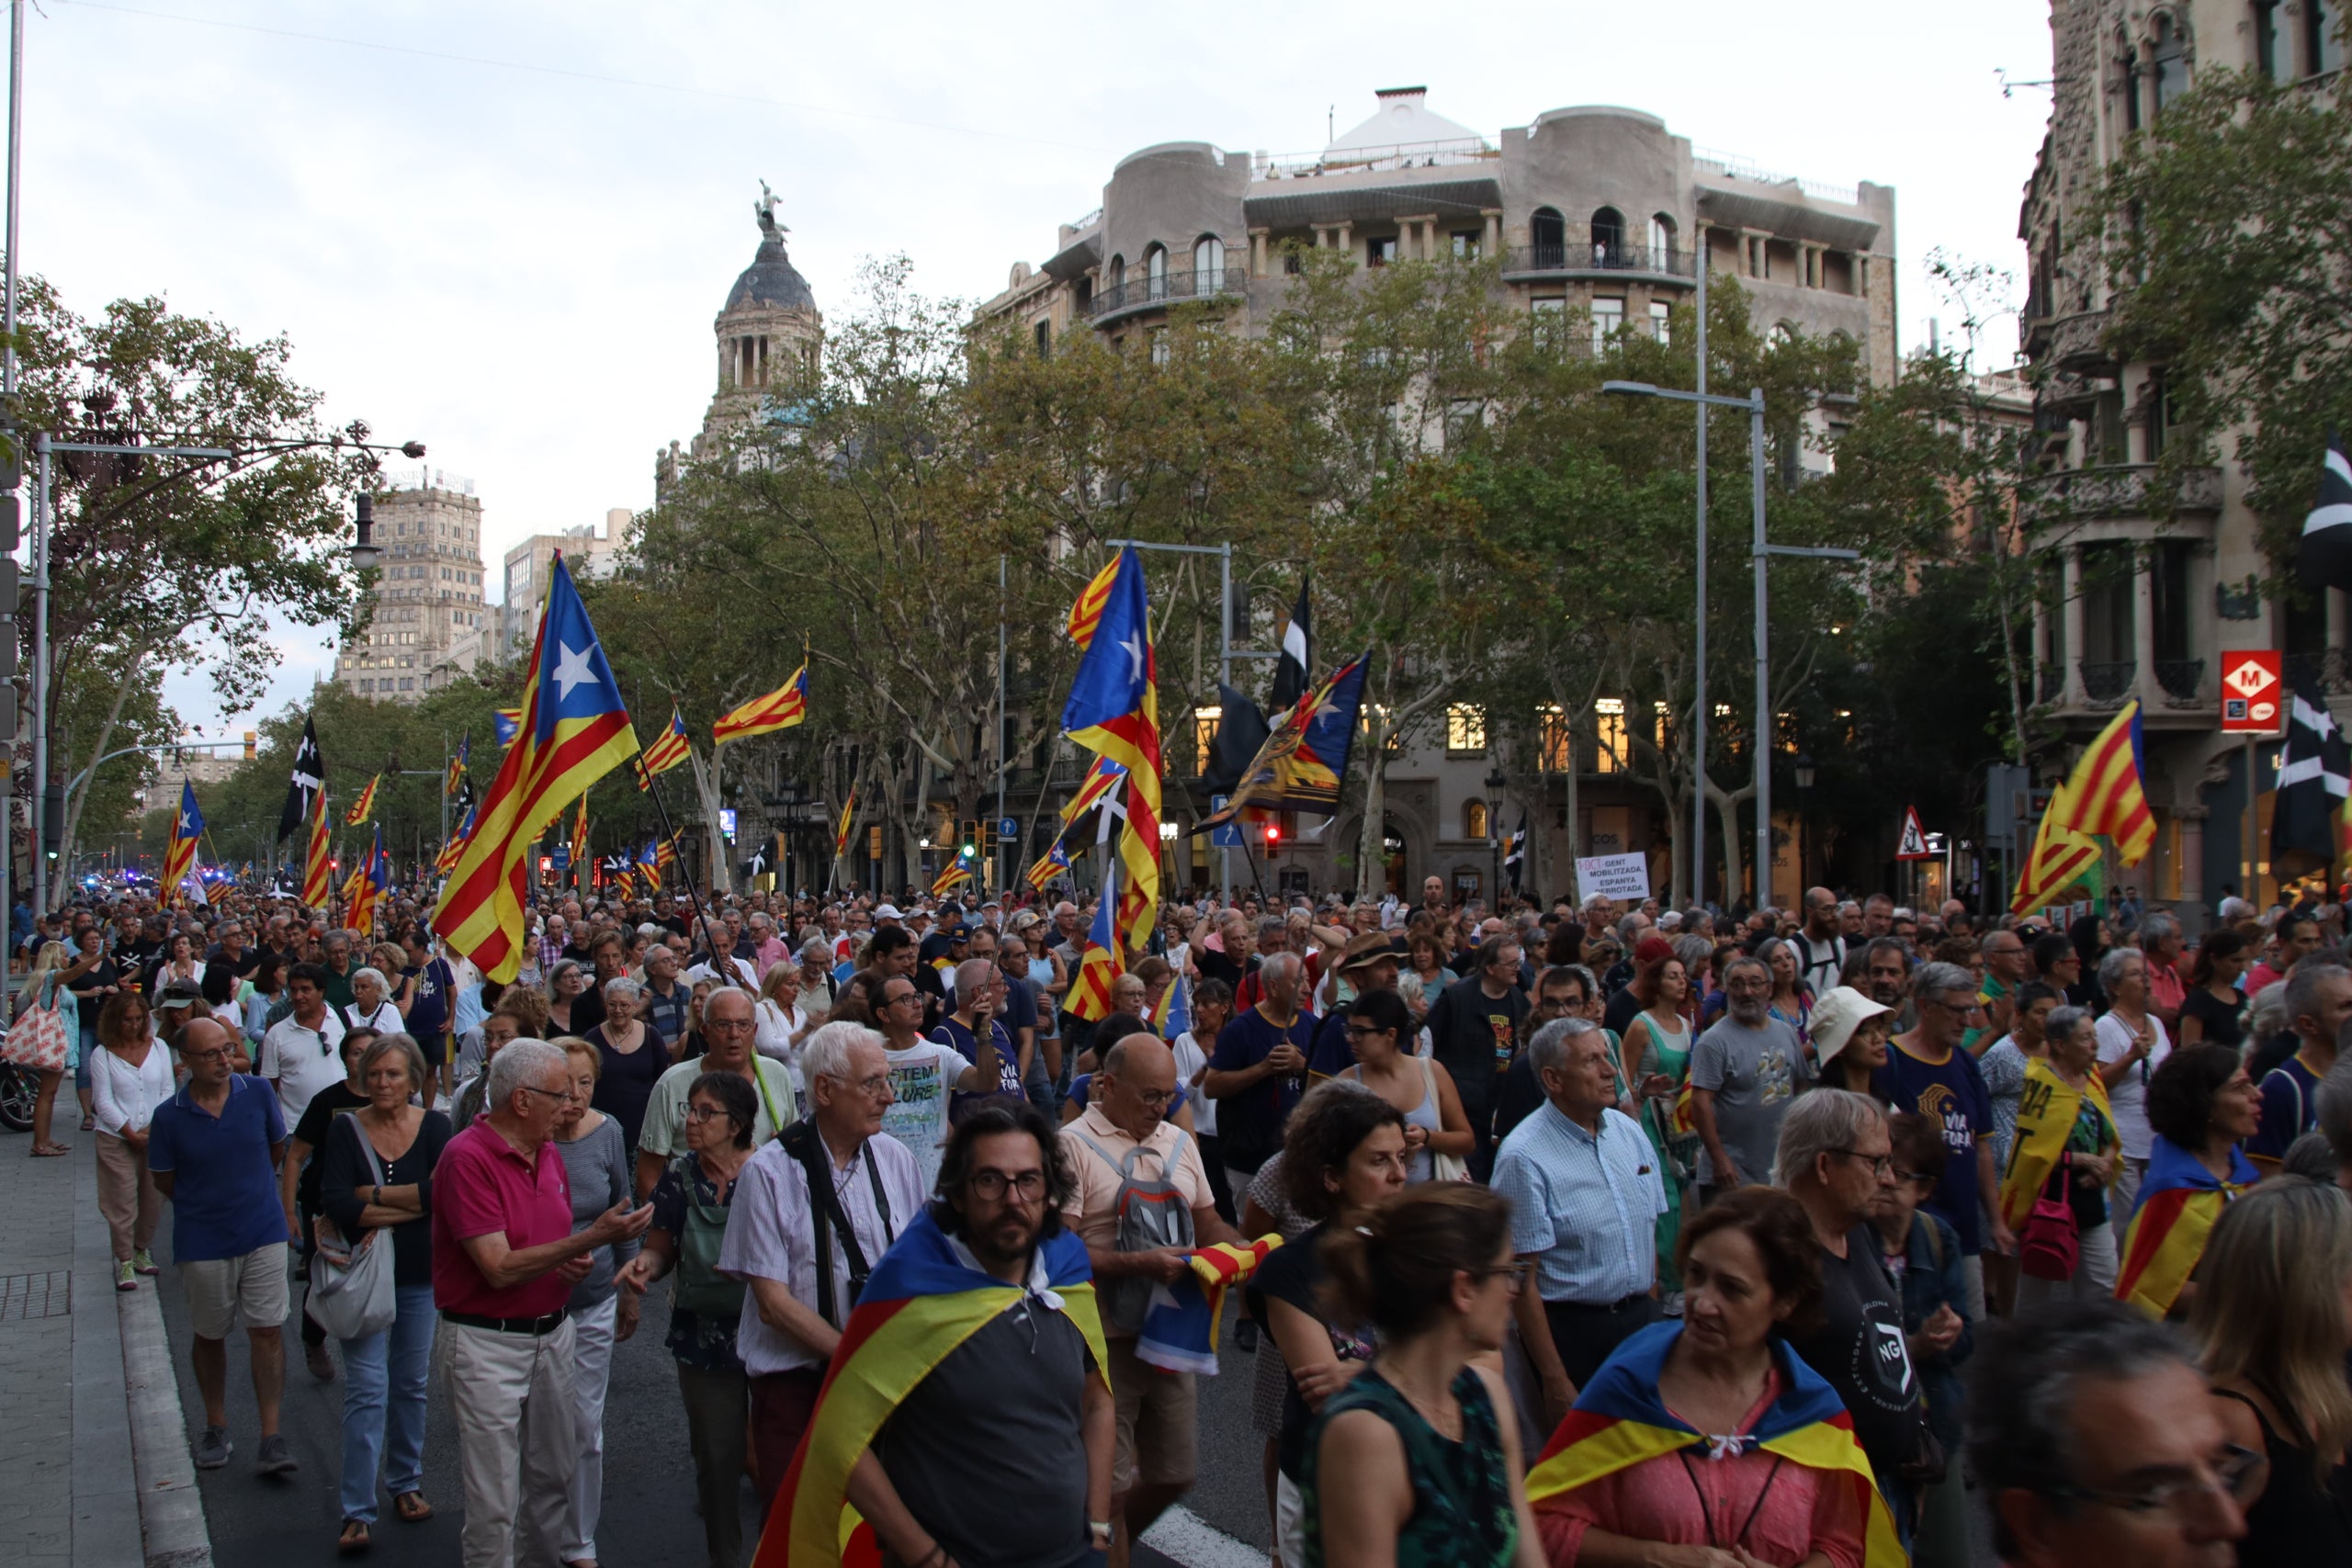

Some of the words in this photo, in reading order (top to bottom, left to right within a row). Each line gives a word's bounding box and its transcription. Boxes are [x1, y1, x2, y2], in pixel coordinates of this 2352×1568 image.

[2242, 671, 2259, 686] M
[1600, 876, 1636, 886] ESPANYA
[891, 1066, 933, 1081] STEM
[1001, 1063, 1018, 1078] VIA
[1945, 1111, 1967, 1131] VIA
[1878, 1340, 1901, 1363] NG
